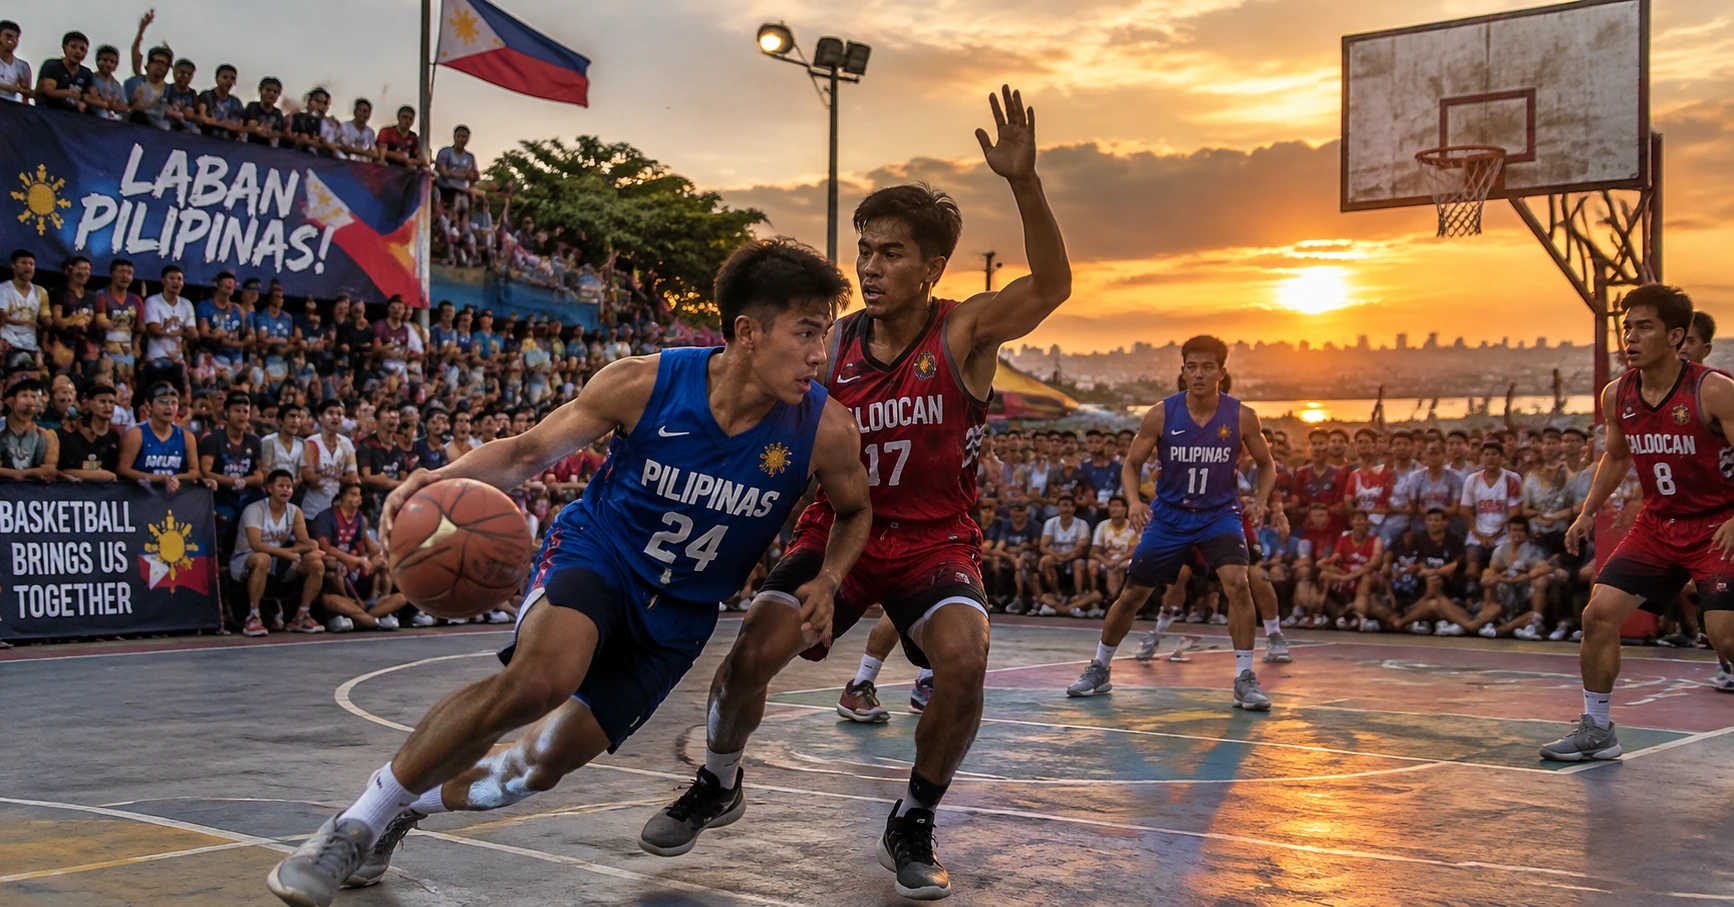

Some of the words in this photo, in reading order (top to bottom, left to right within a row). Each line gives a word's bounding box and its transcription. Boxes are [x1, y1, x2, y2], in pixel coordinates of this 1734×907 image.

[120, 143, 300, 219] LABAN
[74, 192, 335, 275] PILIPINAS!
[848, 394, 943, 433] LOOCAN
[864, 439, 912, 487] 17
[1170, 446, 1231, 463] PILIPINAS
[641, 458, 780, 518] PILIPINAS
[1187, 467, 1209, 495] 11
[1653, 462, 1676, 495] 8
[0, 500, 136, 534] BASKETBALL
[11, 542, 93, 576] BRINGS
[100, 541, 128, 574] US
[643, 511, 729, 572] 24
[13, 581, 133, 619] TOGETHER
